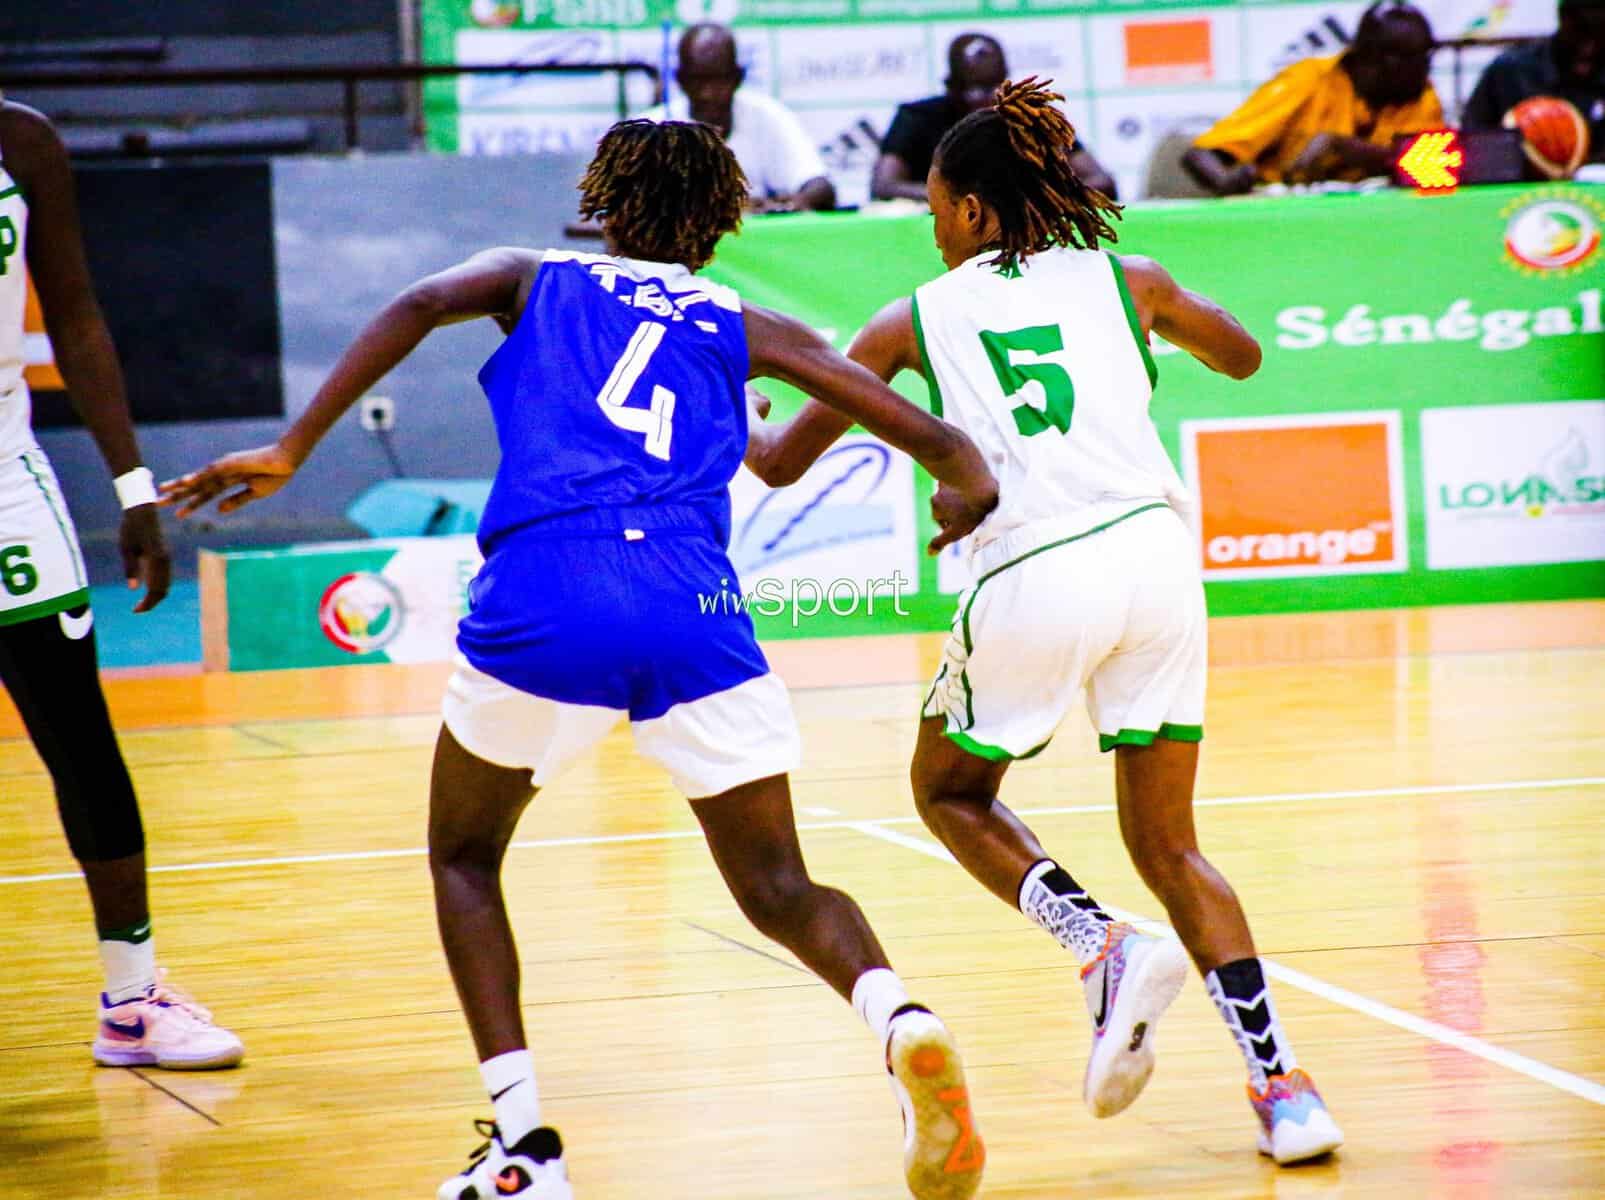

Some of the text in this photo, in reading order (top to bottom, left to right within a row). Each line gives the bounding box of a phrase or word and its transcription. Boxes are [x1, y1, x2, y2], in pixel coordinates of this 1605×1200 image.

[1276, 288, 1604, 351] Sénégal
[596, 321, 677, 462] 4
[978, 323, 1076, 437] 5
[1440, 474, 1605, 511] LONAS
[0, 545, 38, 597] 6
[1207, 527, 1378, 566] orange
